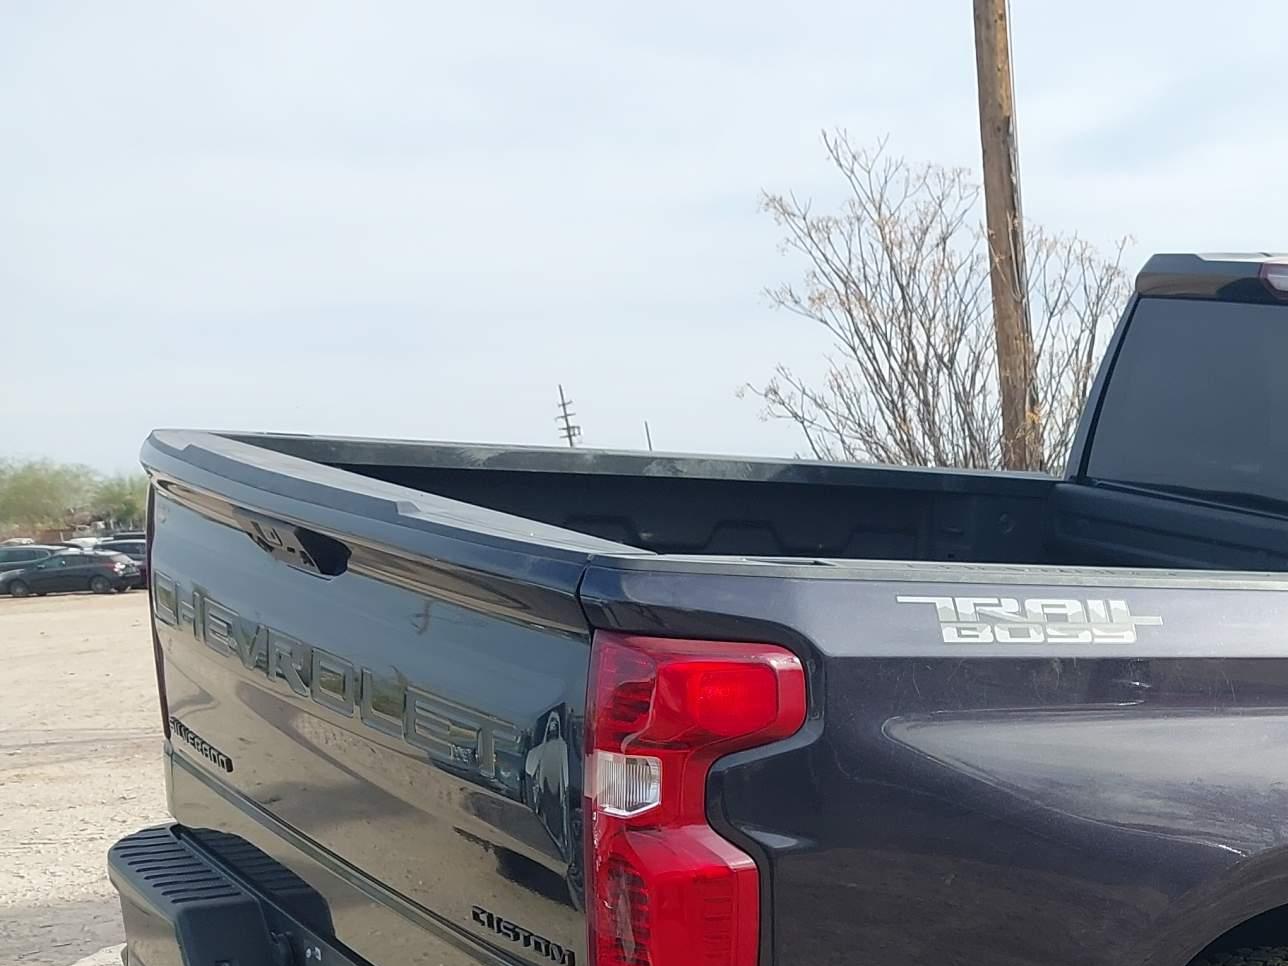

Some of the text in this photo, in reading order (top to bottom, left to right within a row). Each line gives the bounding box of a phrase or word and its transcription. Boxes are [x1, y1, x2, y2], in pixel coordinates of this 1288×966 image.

[896, 595, 1164, 625] TRAIL
[940, 622, 1138, 644] BOSS
[153, 570, 520, 778] CHEVROLET
